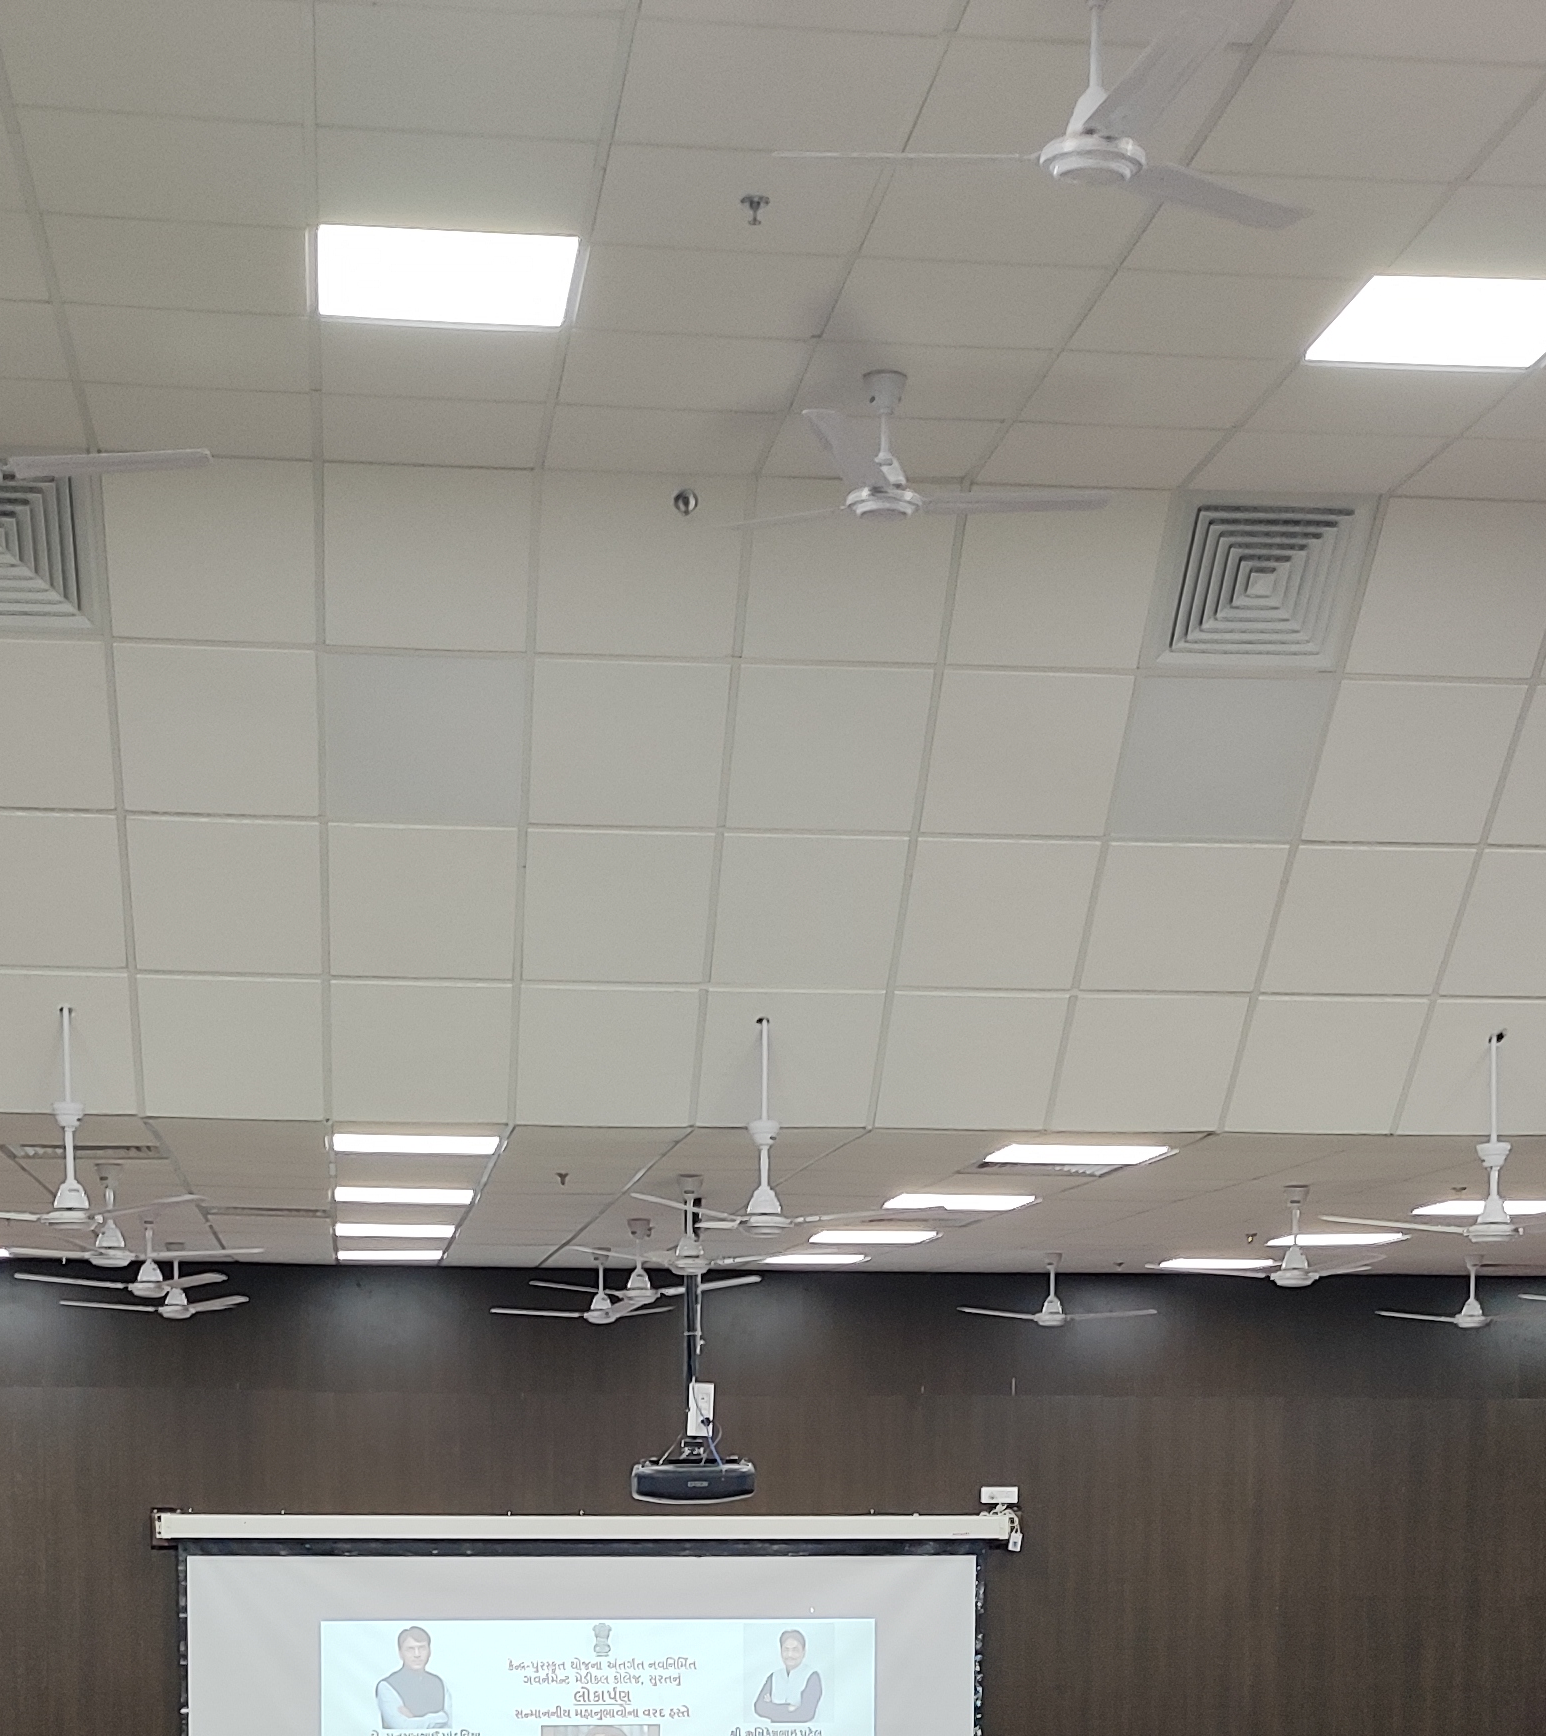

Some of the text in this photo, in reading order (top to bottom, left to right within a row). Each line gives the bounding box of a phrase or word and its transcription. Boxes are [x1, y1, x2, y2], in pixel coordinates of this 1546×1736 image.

[571, 1658, 602, 1671] યોજના
[607, 1658, 644, 1670] અંતર્ગત
[648, 1657, 696, 1670] નવનિર્મિત
[524, 1671, 681, 1686] ગવર્નમેન્ટ મેડીકલ કોલેજ, સુરતનું
[573, 1687, 632, 1702] લોકાર્પણ
[515, 1705, 690, 1720] સન્માનનીય મહાનુભાવોના વરદ હસ્તે
